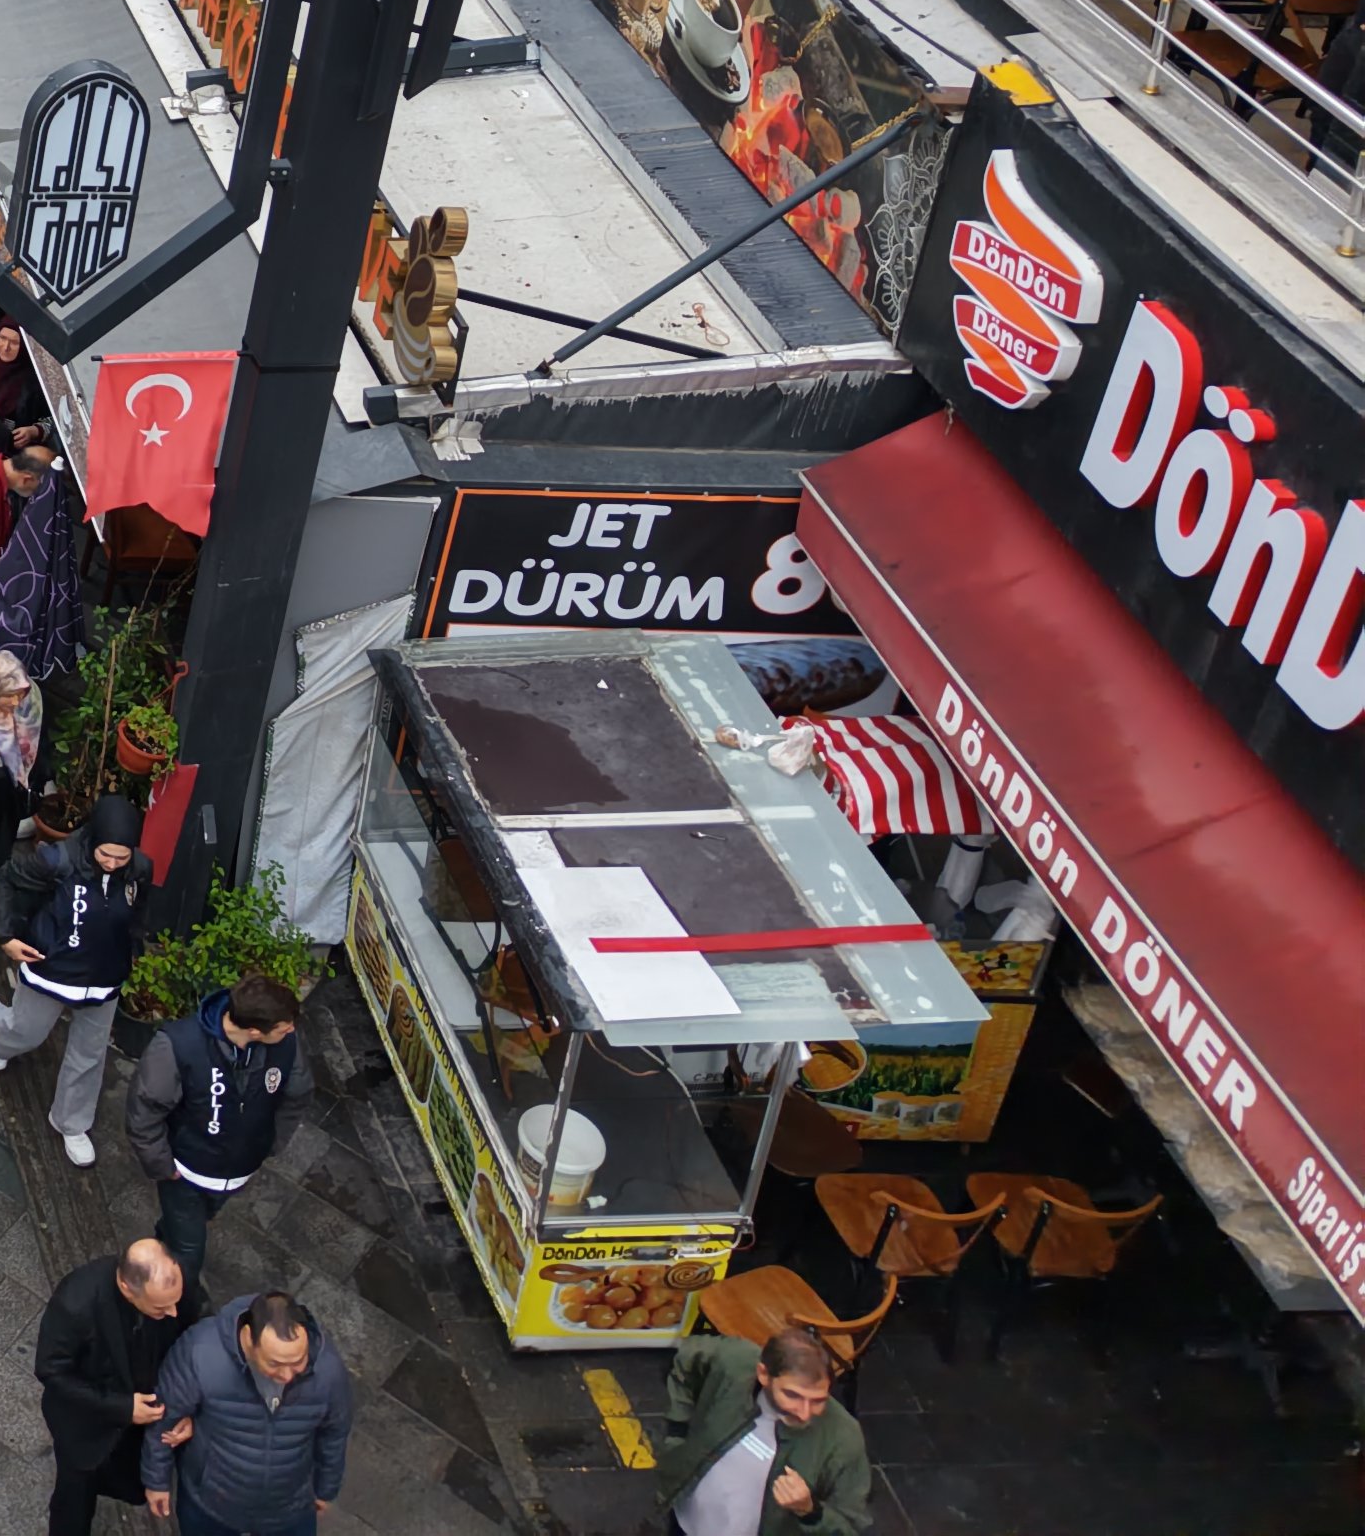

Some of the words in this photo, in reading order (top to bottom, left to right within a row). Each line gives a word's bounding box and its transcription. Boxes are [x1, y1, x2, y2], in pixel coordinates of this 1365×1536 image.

[966, 227, 1067, 312] DönDön
[971, 305, 1039, 367] Döner
[547, 501, 671, 551] JET
[447, 558, 726, 623] DÜRÜM
[934, 682, 1079, 899] DönDön
[1090, 895, 1259, 1133] DÖNER
[542, 1245, 606, 1261] DönDön
